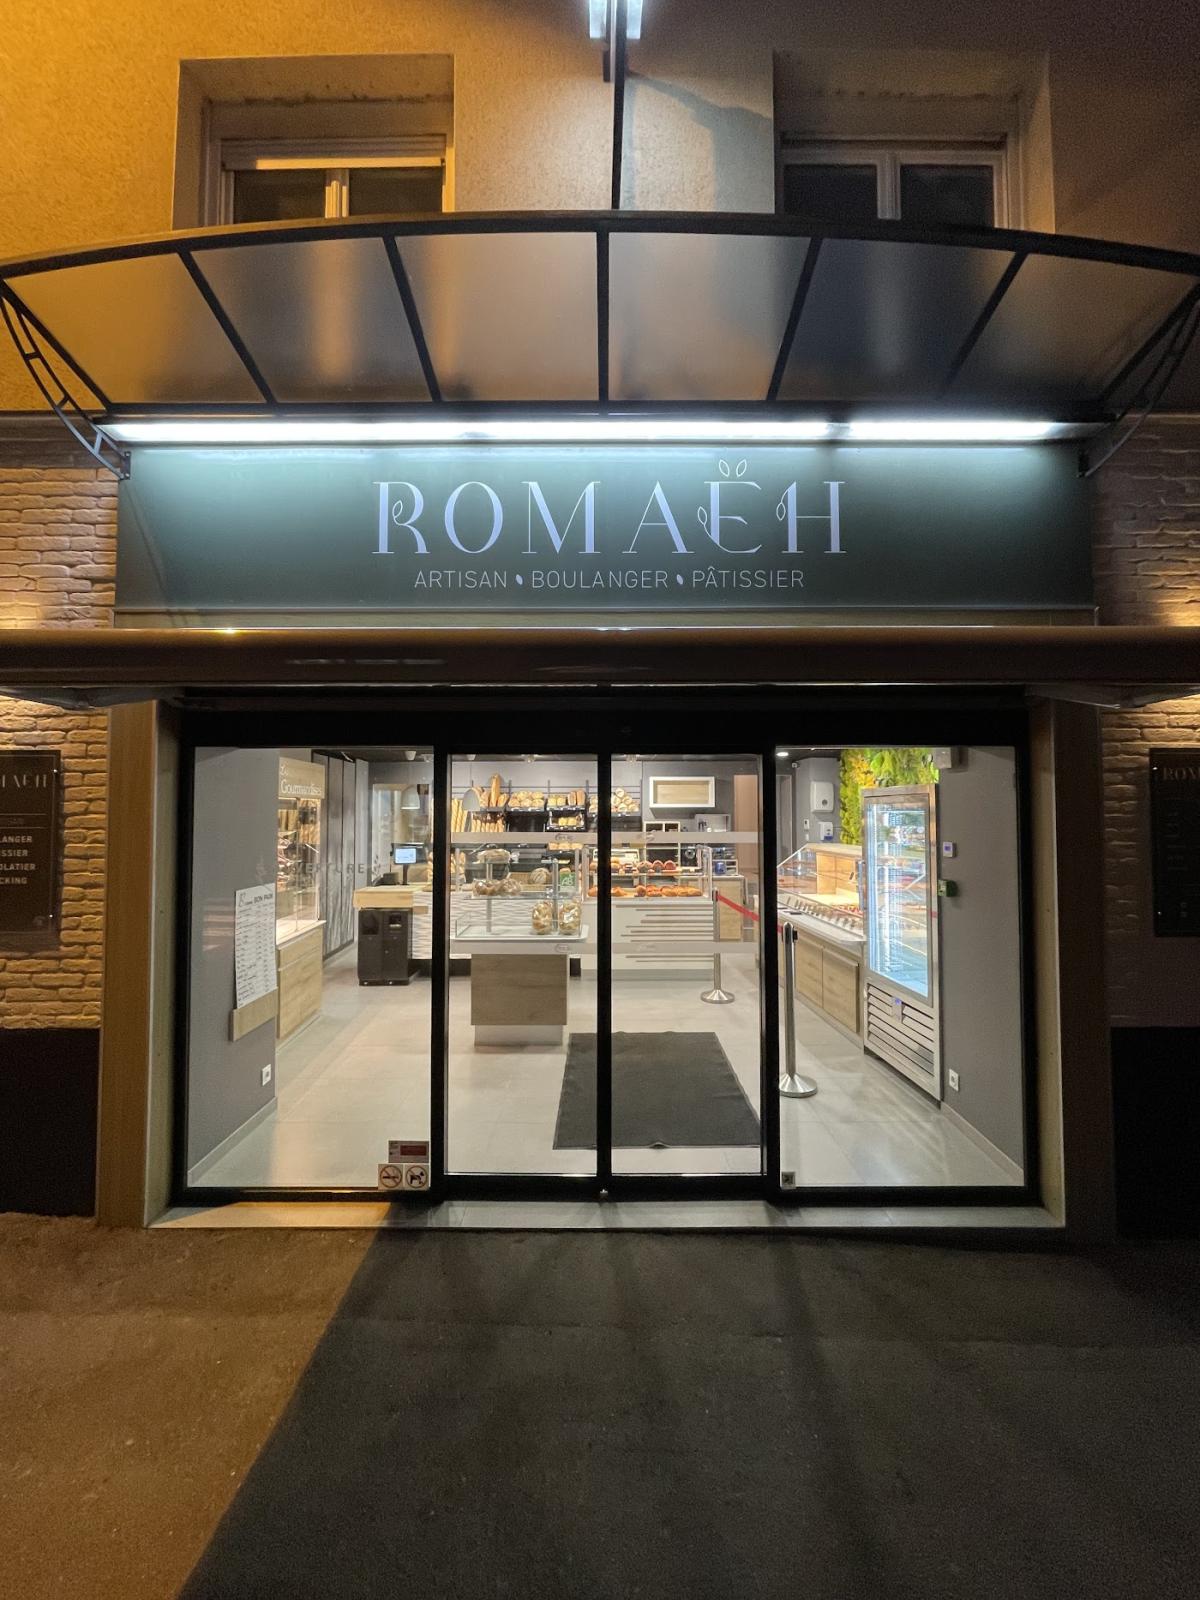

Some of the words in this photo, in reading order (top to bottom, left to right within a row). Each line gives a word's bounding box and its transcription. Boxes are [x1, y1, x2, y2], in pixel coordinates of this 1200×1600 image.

[372, 459, 846, 555] ROMAËH
[414, 570, 507, 589] ARTISAN
[531, 570, 669, 589] BOULANGER
[692, 565, 804, 589] PÂTISSIER
[0, 835, 33, 843] ANGER
